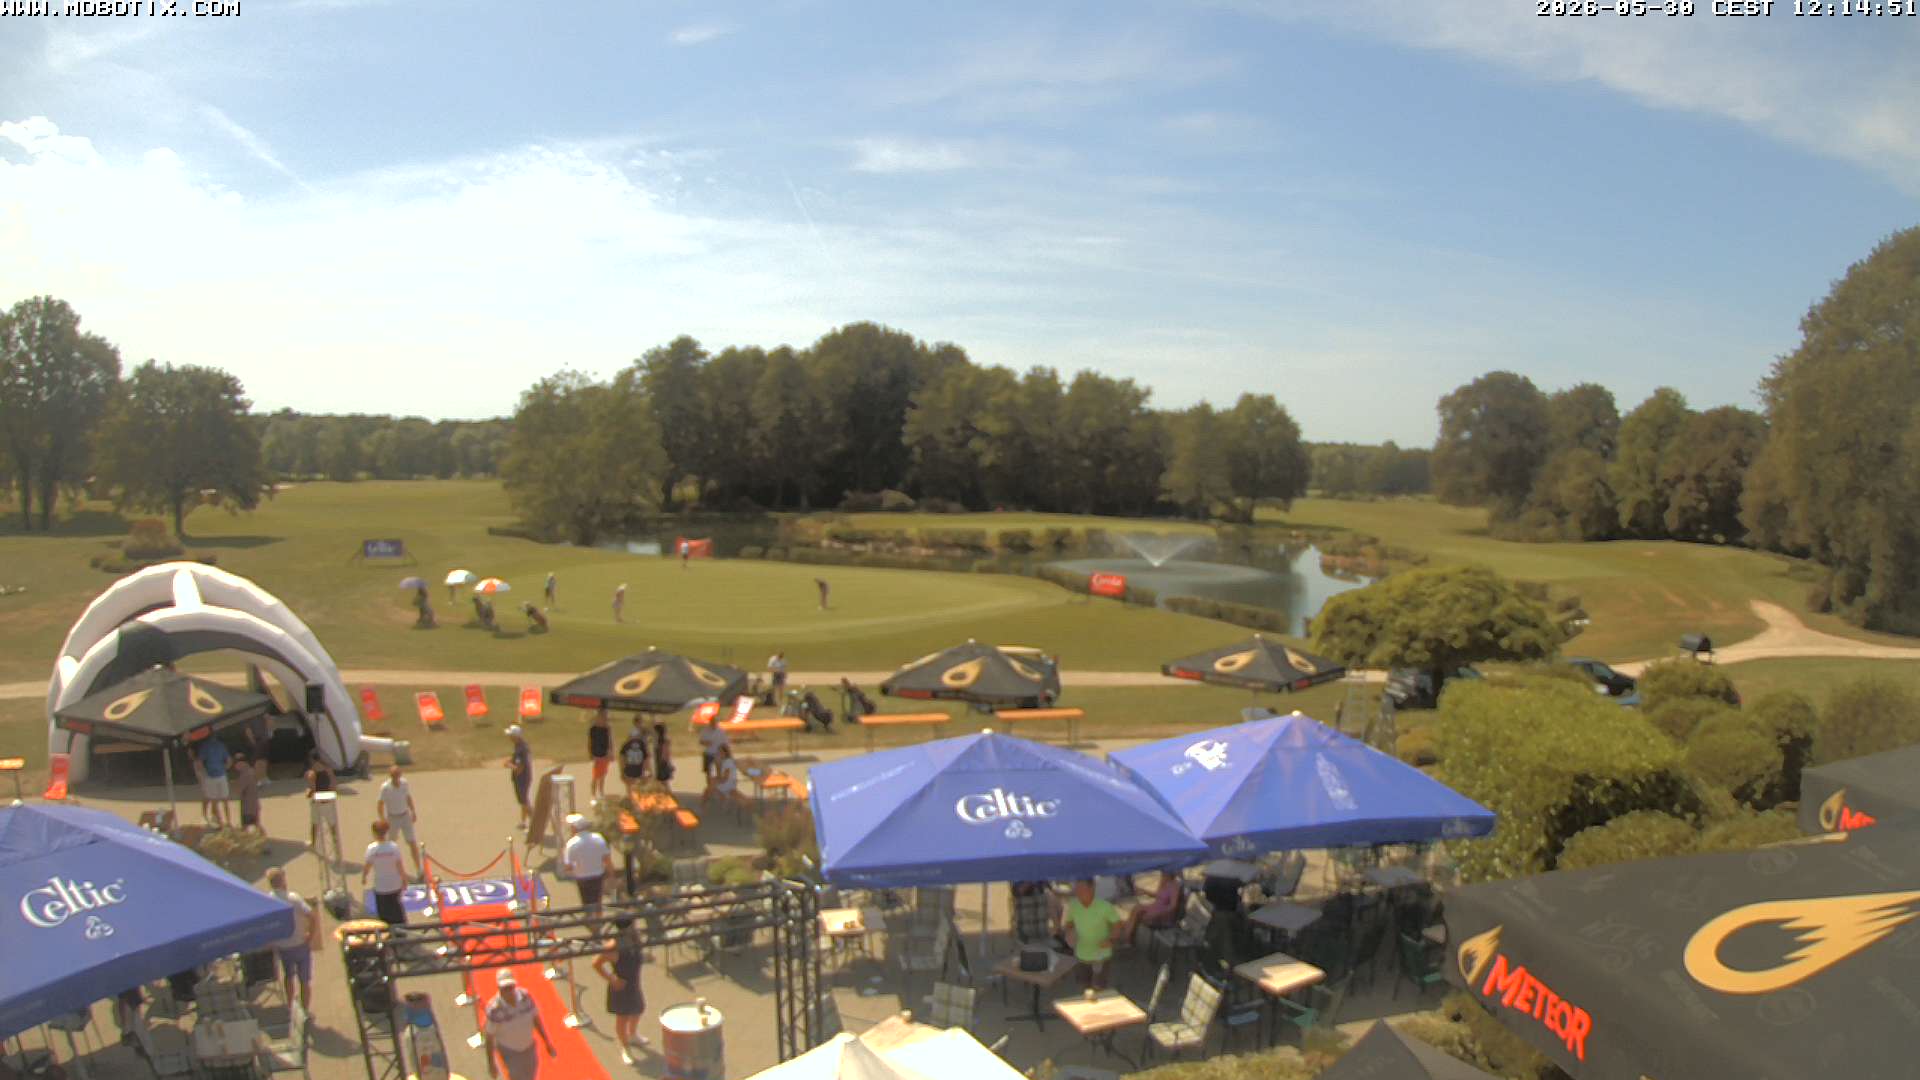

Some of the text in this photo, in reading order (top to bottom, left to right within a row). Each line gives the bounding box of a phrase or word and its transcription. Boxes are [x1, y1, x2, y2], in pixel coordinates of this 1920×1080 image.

[956, 787, 1058, 824] Celtic
[20, 875, 127, 928] Celtic
[1481, 953, 1593, 1062] METEOR
